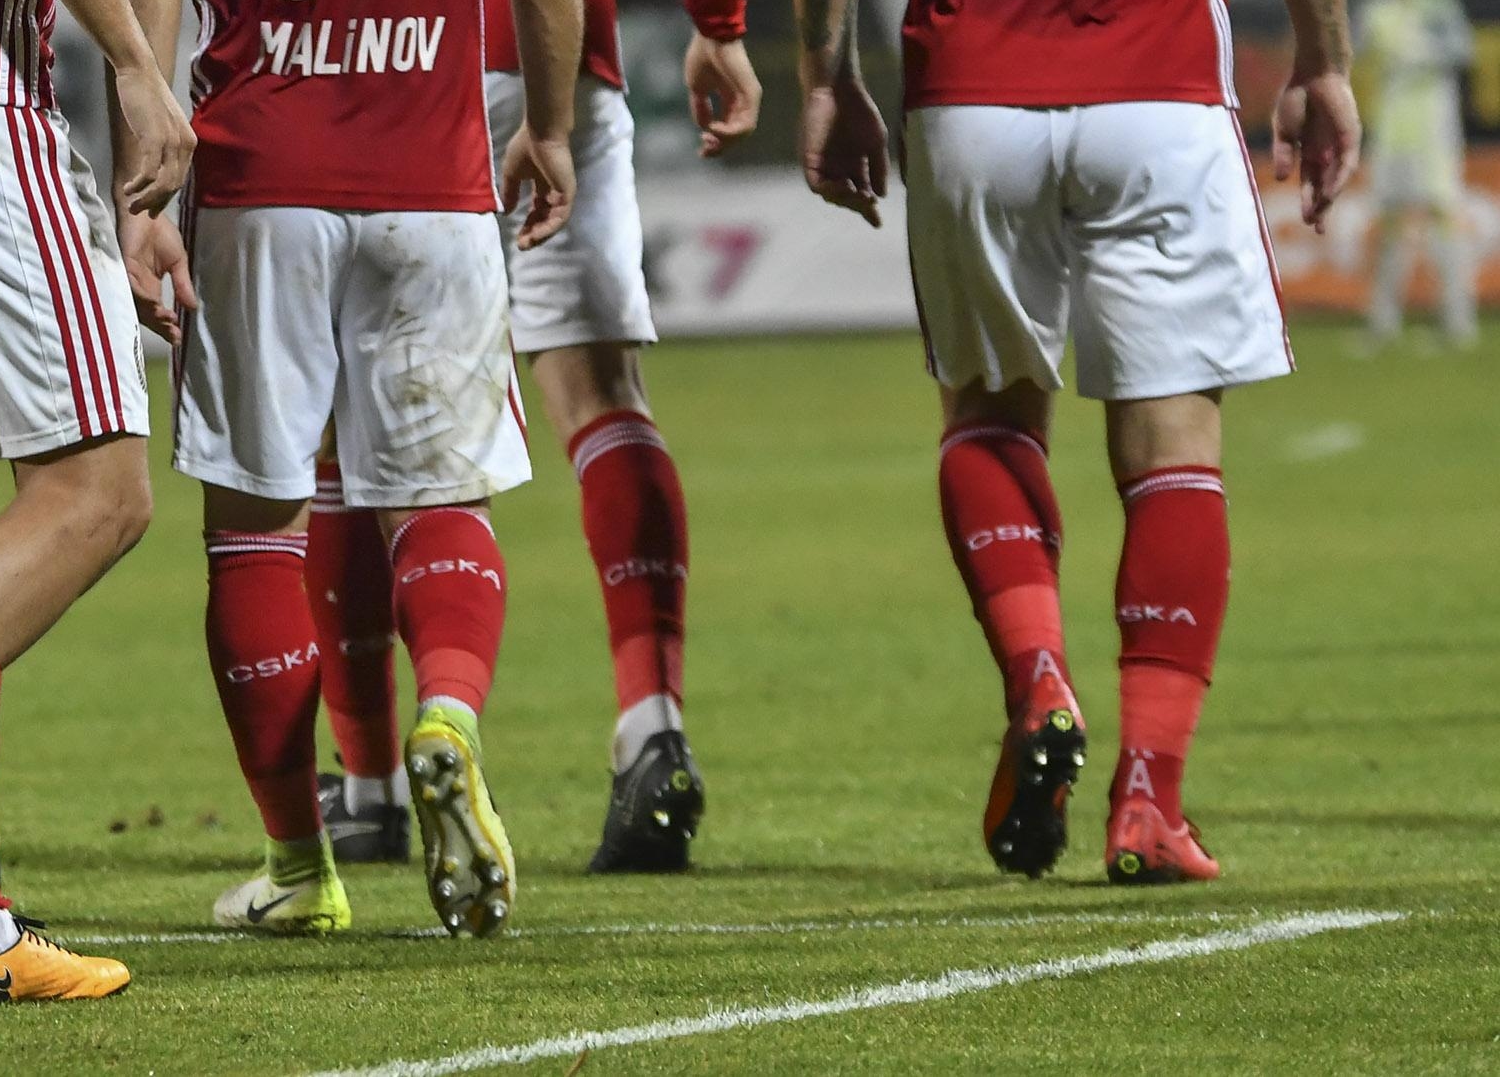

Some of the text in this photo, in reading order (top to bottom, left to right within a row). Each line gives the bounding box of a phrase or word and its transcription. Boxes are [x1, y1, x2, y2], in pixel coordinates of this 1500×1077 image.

[401, 559, 501, 590] CSKA
[1119, 604, 1197, 626] SKA
[226, 641, 320, 683] CSKA
